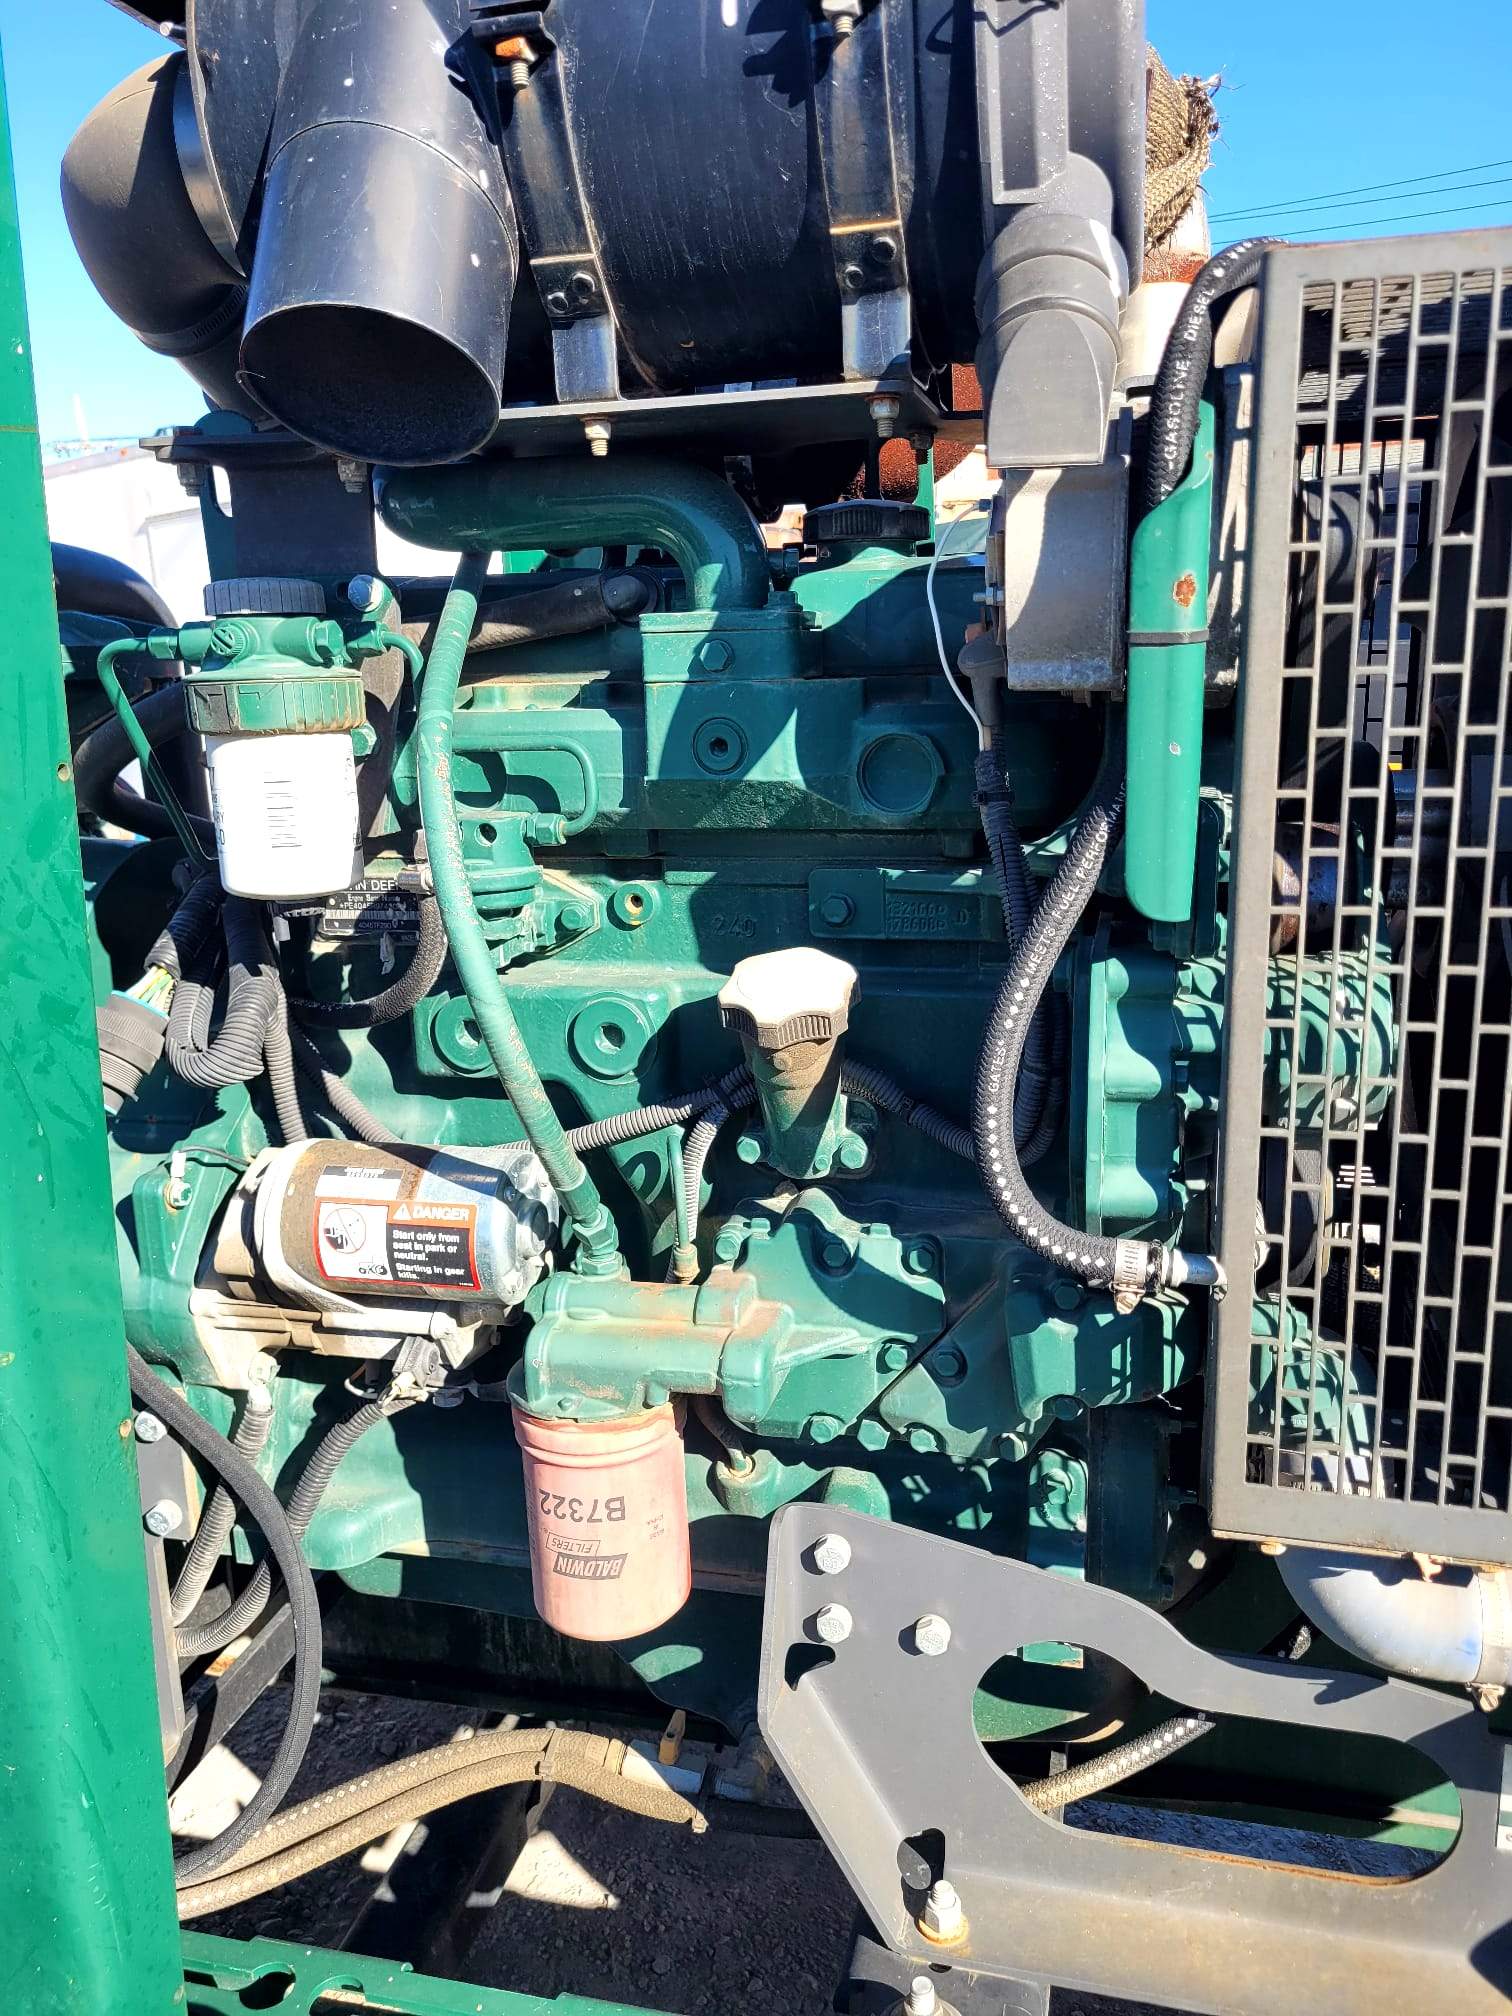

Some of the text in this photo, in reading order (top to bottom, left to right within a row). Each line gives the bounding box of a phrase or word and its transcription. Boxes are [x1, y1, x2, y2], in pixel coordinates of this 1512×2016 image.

[1183, 286, 1216, 342] DIESEL
[1024, 925, 1057, 976] MEETS
[1052, 882, 1081, 919] FUEL
[412, 1204, 470, 1221] DANGER
[392, 1229, 460, 1244] Start only from
[392, 1241, 458, 1254] seat in park or
[393, 1251, 429, 1261] neutral.
[395, 1262, 465, 1276] Starting in gear
[397, 1271, 420, 1280] kills.
[538, 1488, 626, 1524] B7322
[551, 1536, 593, 1554] FILTERS
[555, 1556, 625, 1579] BALDWIN
